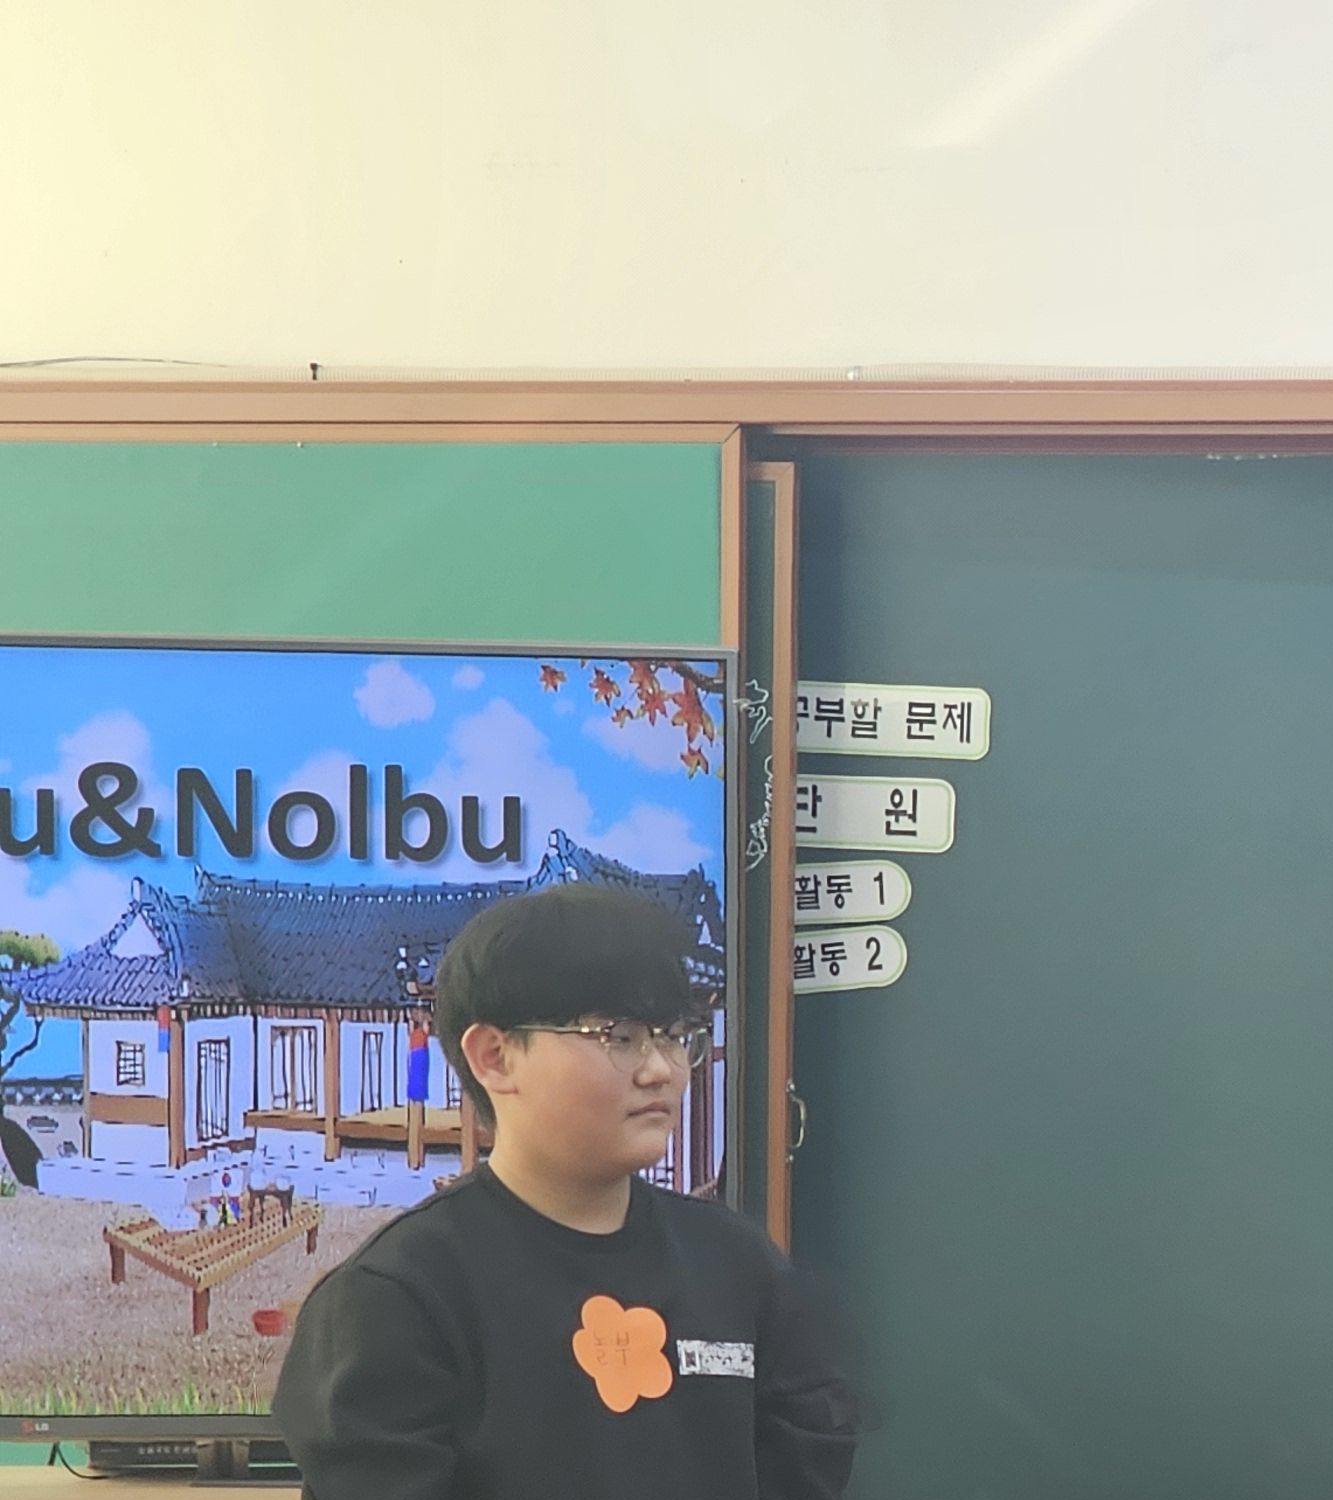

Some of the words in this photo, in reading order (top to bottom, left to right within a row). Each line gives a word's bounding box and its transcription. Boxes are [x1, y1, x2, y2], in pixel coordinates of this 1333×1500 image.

[905, 700, 973, 745] 문제
[884, 787, 919, 837] 원
[795, 874, 853, 911] 활동
[873, 872, 886, 906] 1
[865, 937, 883, 971] 2
